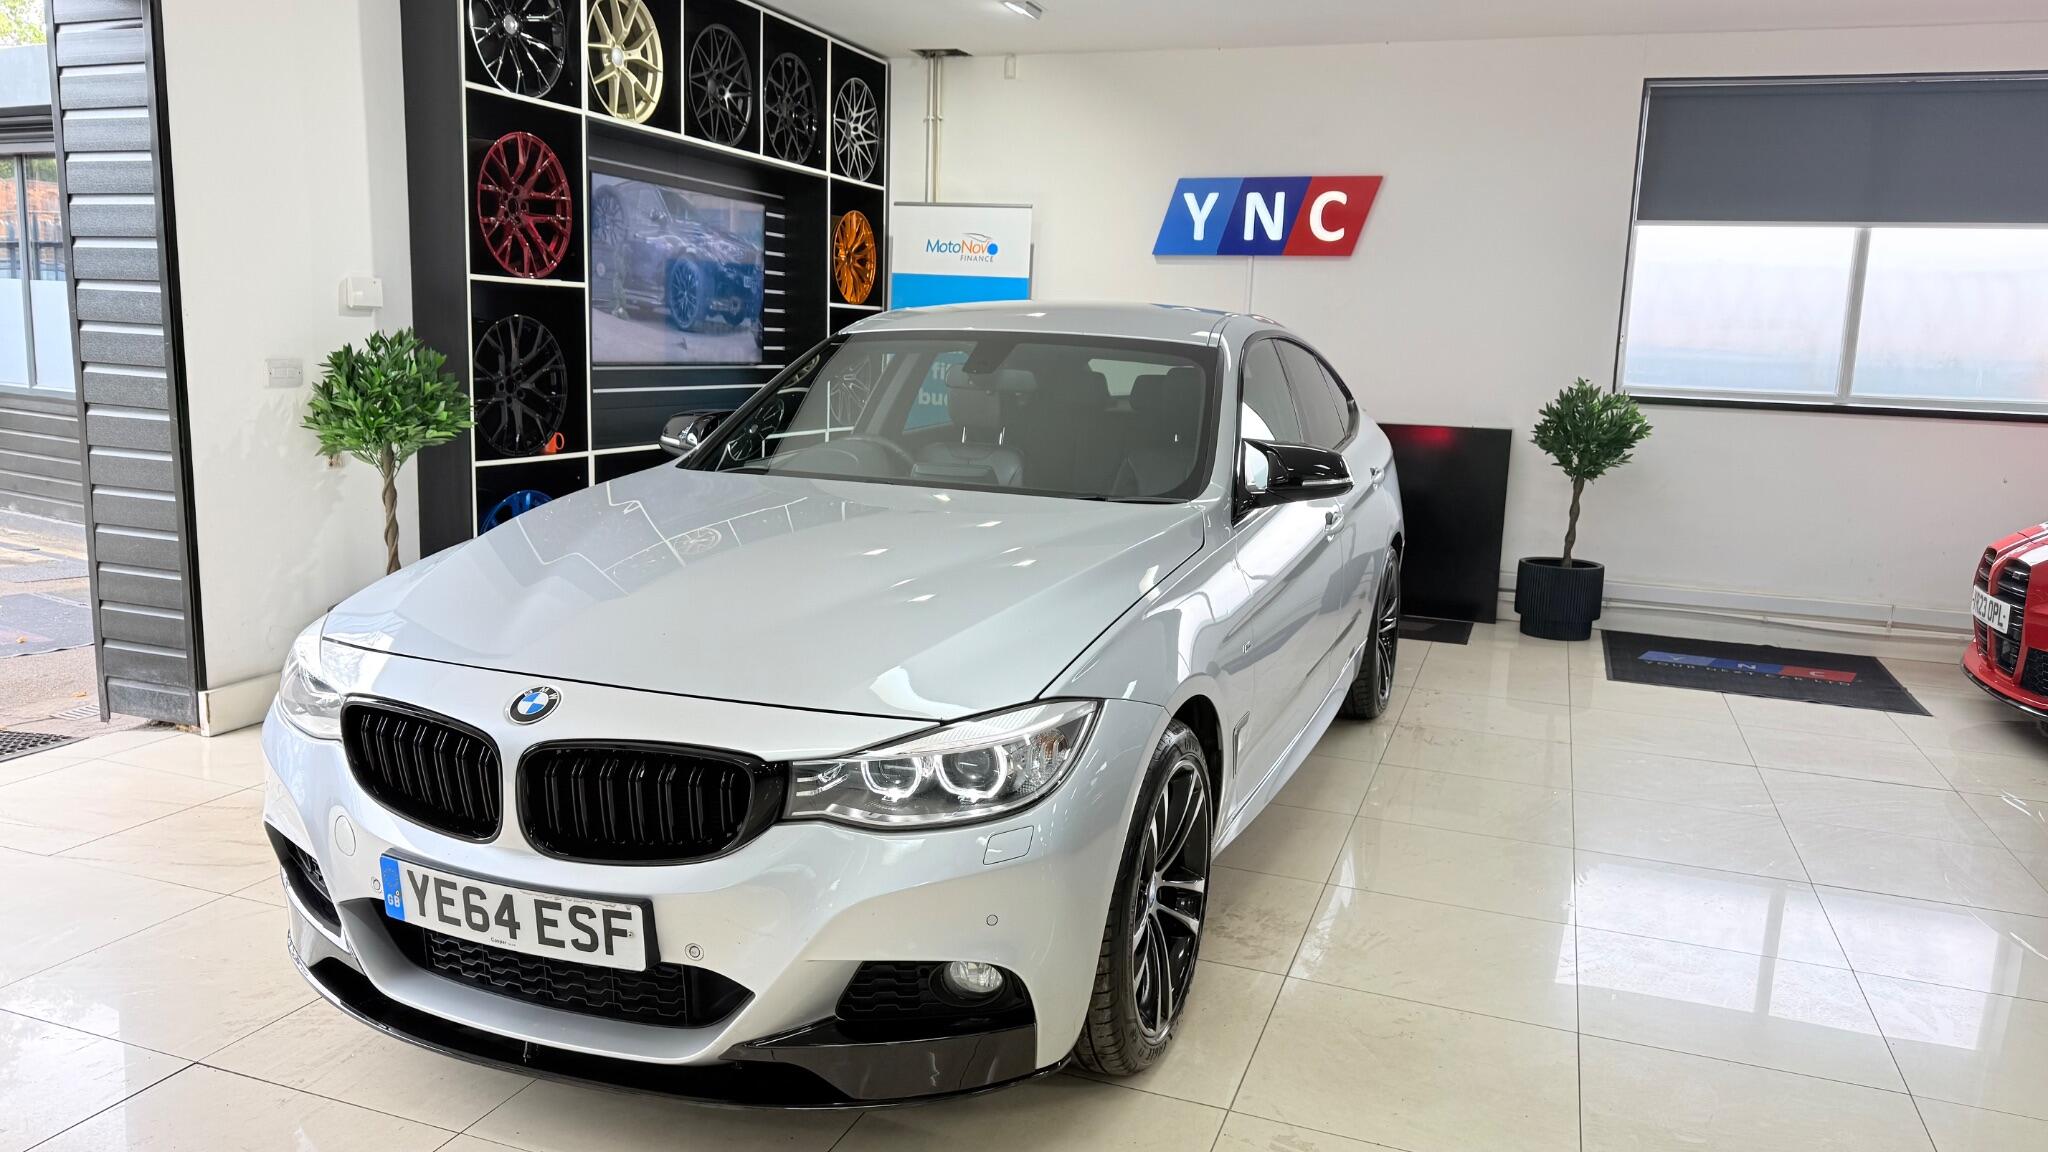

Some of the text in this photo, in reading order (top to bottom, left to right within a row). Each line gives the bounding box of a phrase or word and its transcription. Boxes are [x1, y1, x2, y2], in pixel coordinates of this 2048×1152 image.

[1183, 190, 1348, 242] YNC
[960, 255, 994, 263] FINANCE
[387, 894, 400, 908] GB
[406, 869, 633, 956] YE64 ESF
